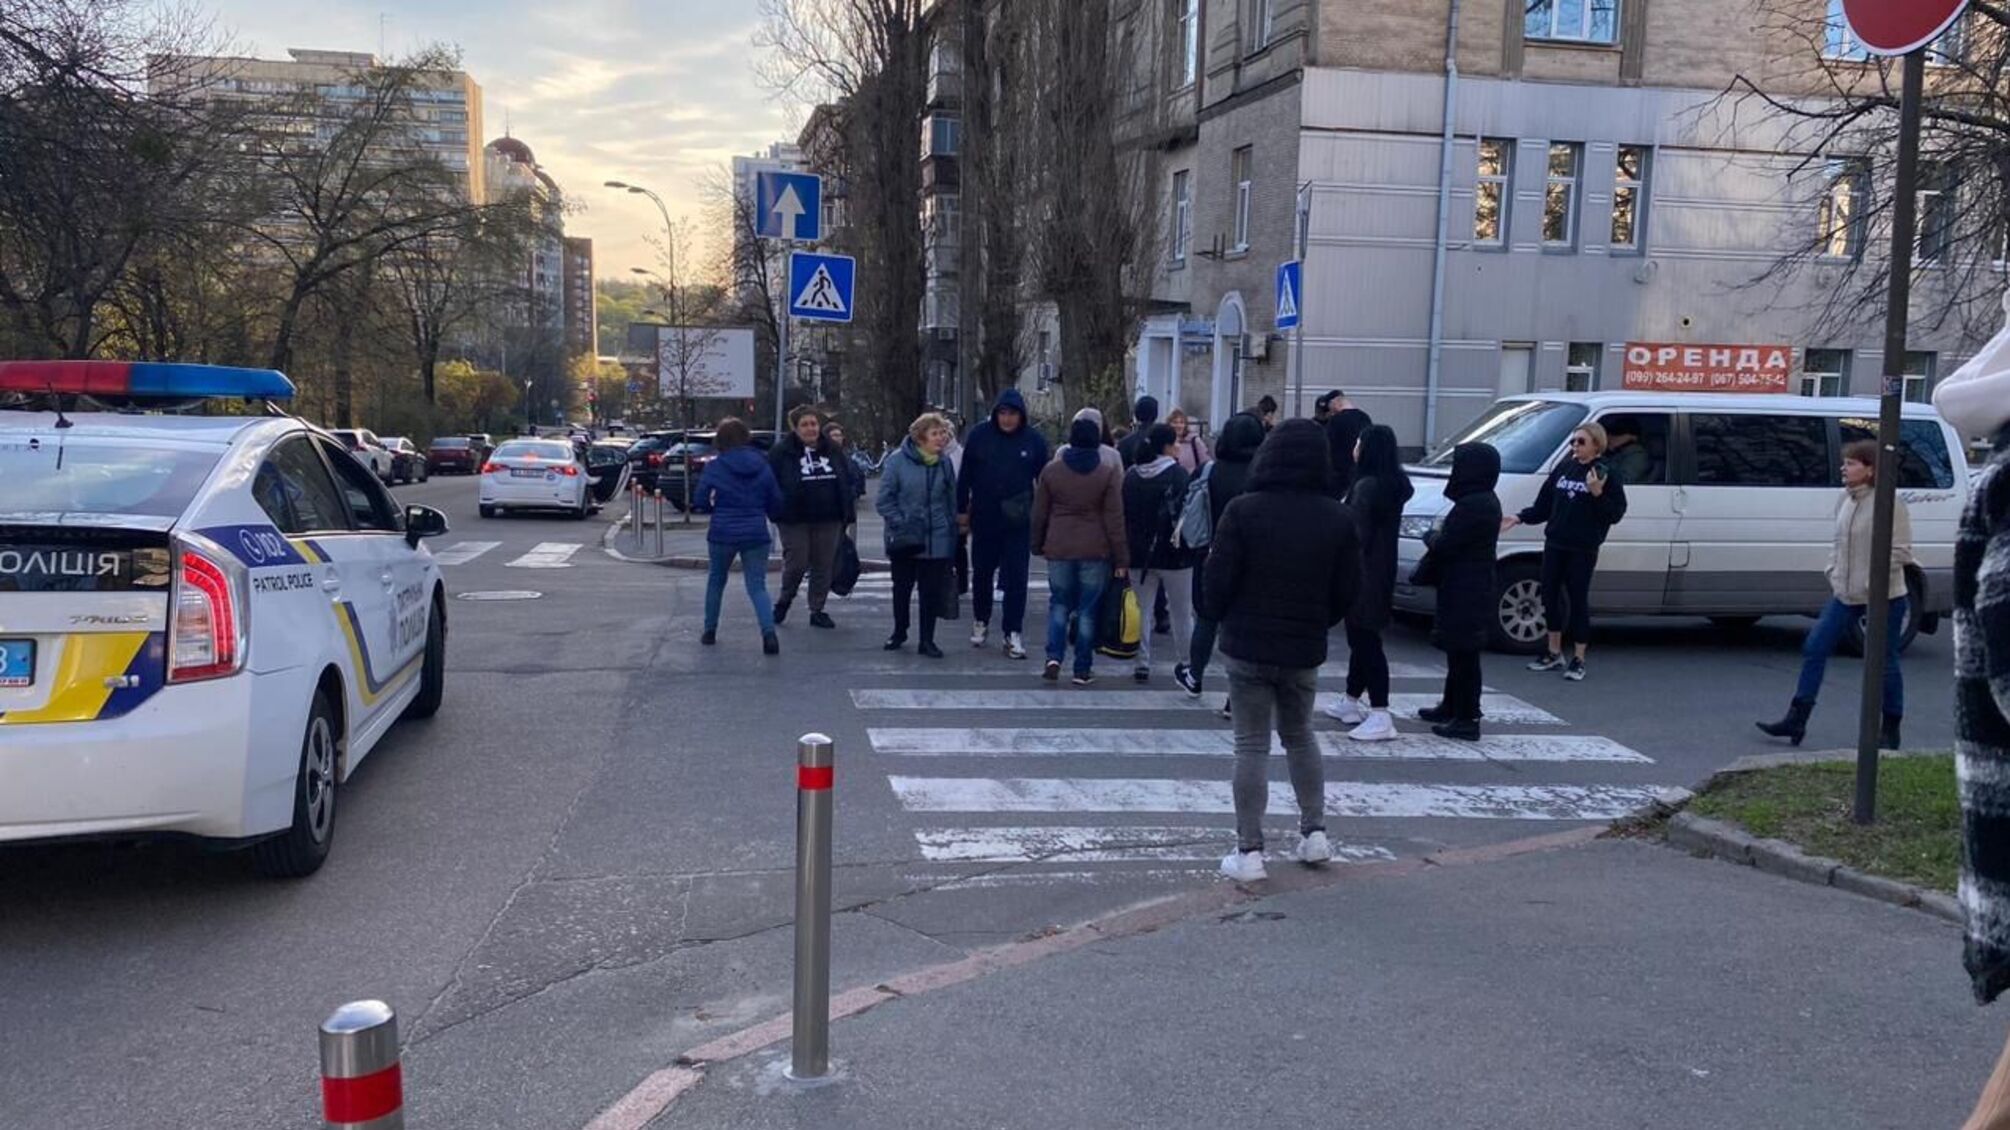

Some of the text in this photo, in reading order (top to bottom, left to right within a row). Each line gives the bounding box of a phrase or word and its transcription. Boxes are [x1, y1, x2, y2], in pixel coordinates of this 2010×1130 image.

[1628, 347, 1786, 370] ОРЕНДА
[253, 573, 313, 593] PATROL POLICE
